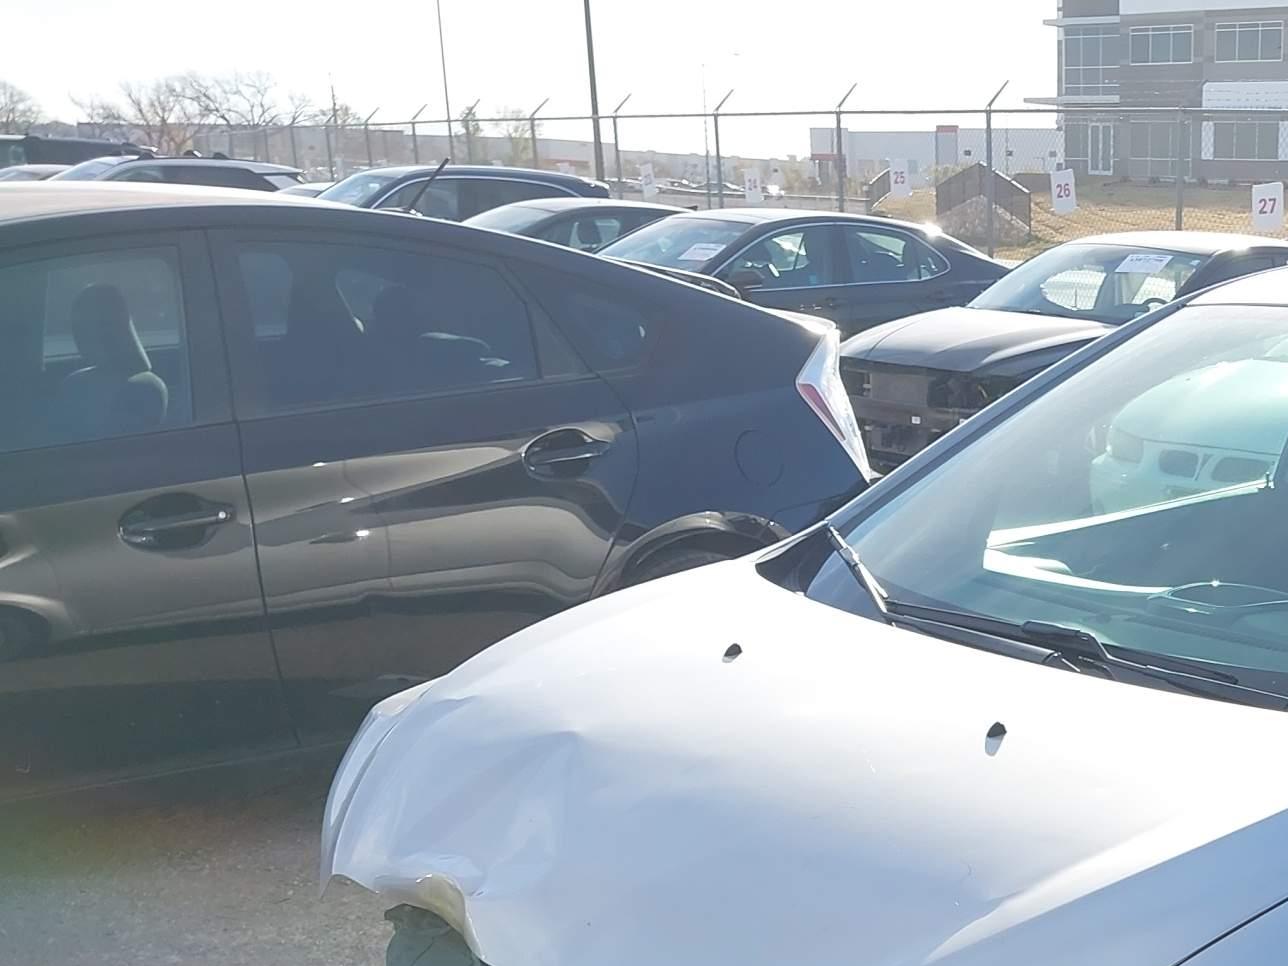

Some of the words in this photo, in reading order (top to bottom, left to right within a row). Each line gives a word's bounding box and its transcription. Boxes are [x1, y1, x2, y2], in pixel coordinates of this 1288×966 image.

[893, 171, 906, 185] 25
[1055, 183, 1071, 199] 26
[1258, 198, 1277, 214] 27
